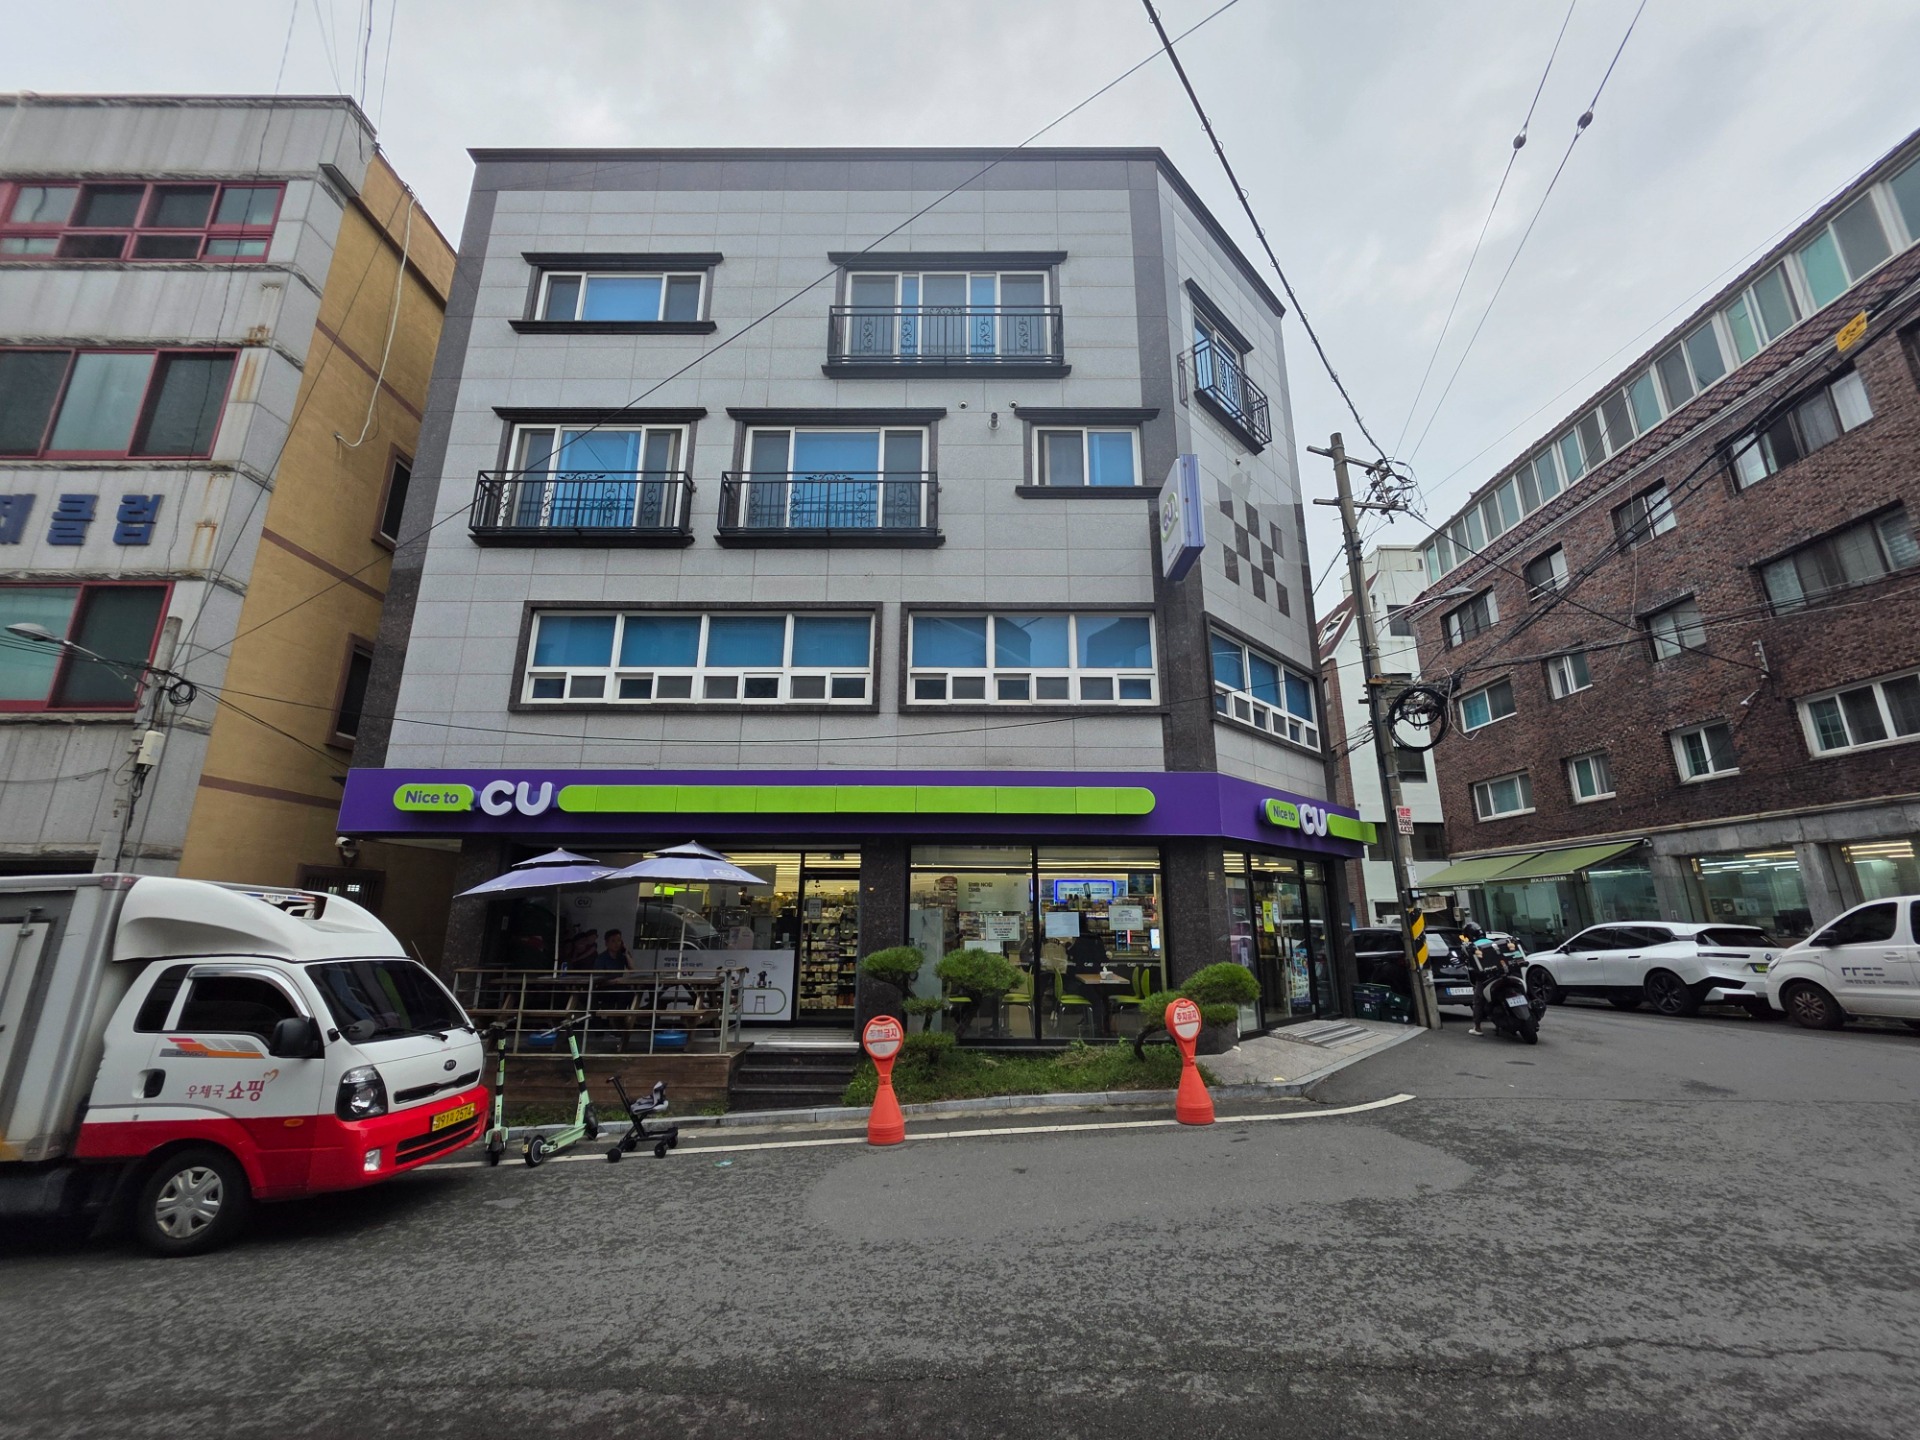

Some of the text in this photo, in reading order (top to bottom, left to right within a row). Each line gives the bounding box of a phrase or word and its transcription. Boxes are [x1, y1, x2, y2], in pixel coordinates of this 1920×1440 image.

[405, 780, 553, 816] Nice to CU
[1273, 803, 1327, 837] Nice to CU
[185, 1080, 266, 1101] 우체국 쇼핑
